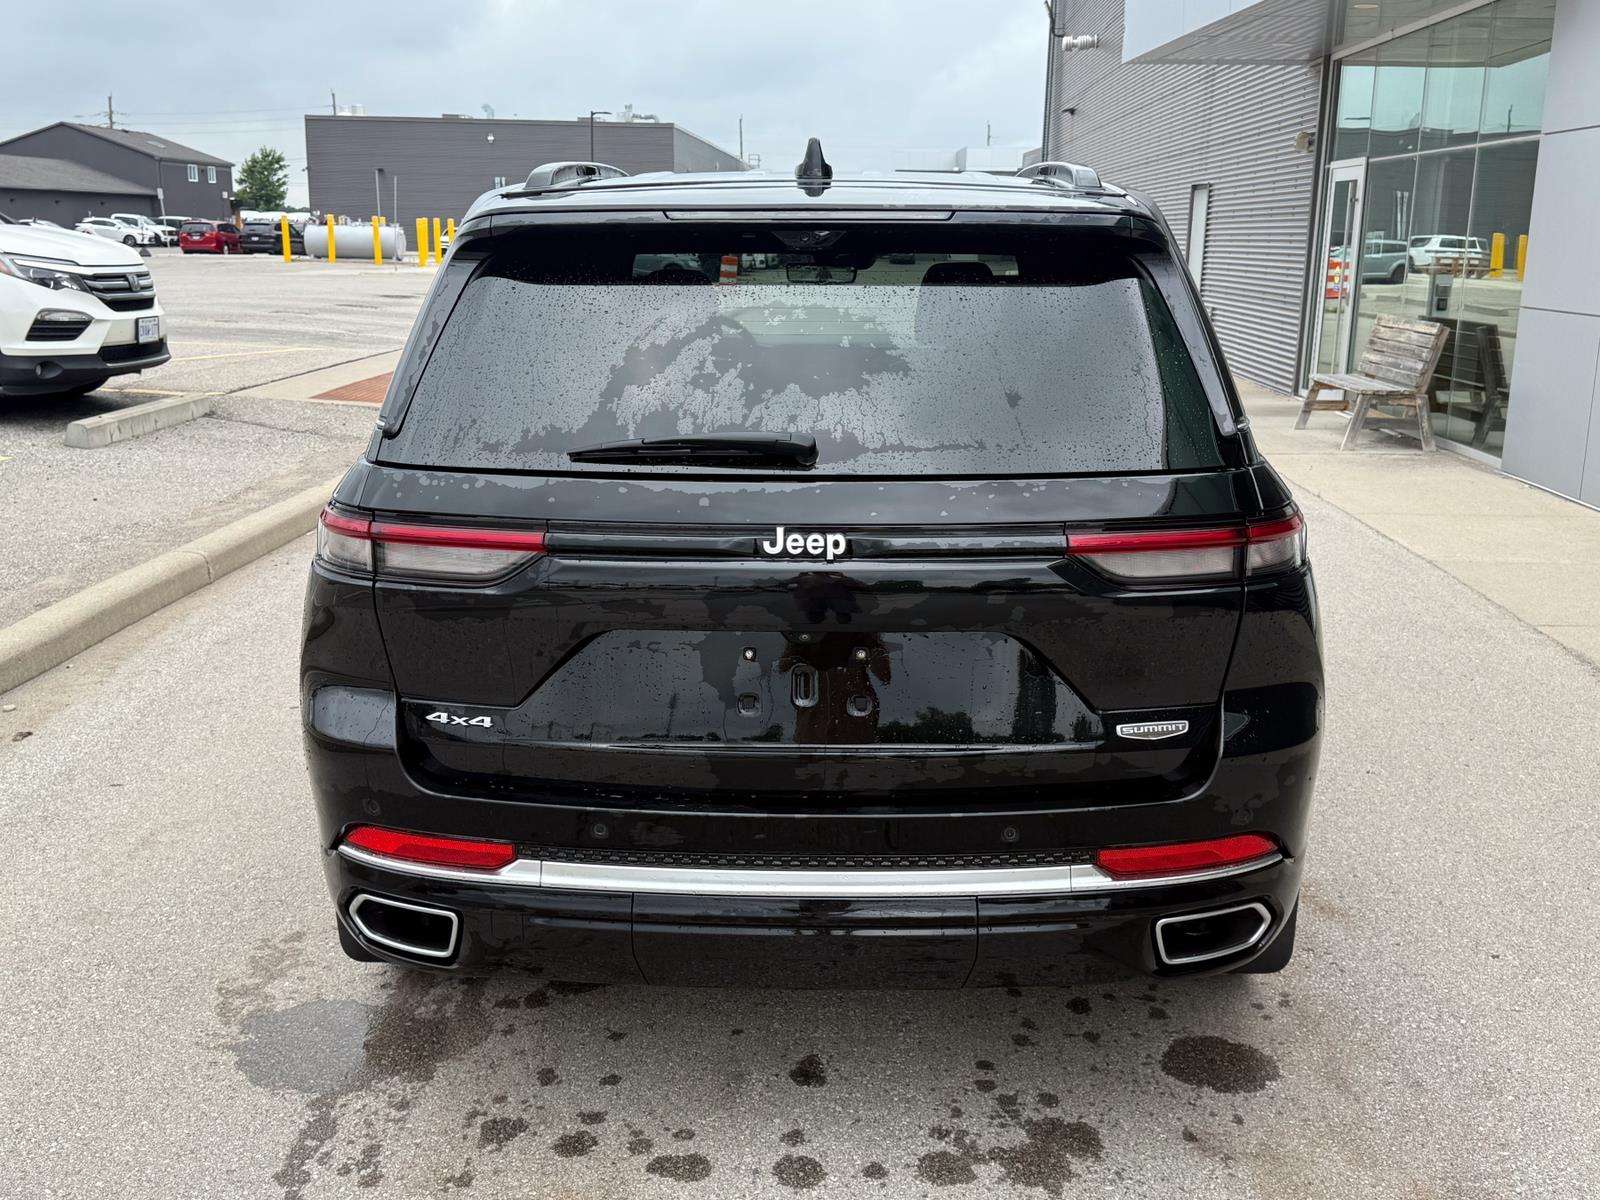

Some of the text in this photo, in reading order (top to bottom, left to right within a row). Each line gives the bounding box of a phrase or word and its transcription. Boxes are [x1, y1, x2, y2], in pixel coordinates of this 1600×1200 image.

[762, 526, 846, 560] Jeep
[425, 711, 494, 728] 4x4
[1122, 723, 1186, 735] SUMMIT
